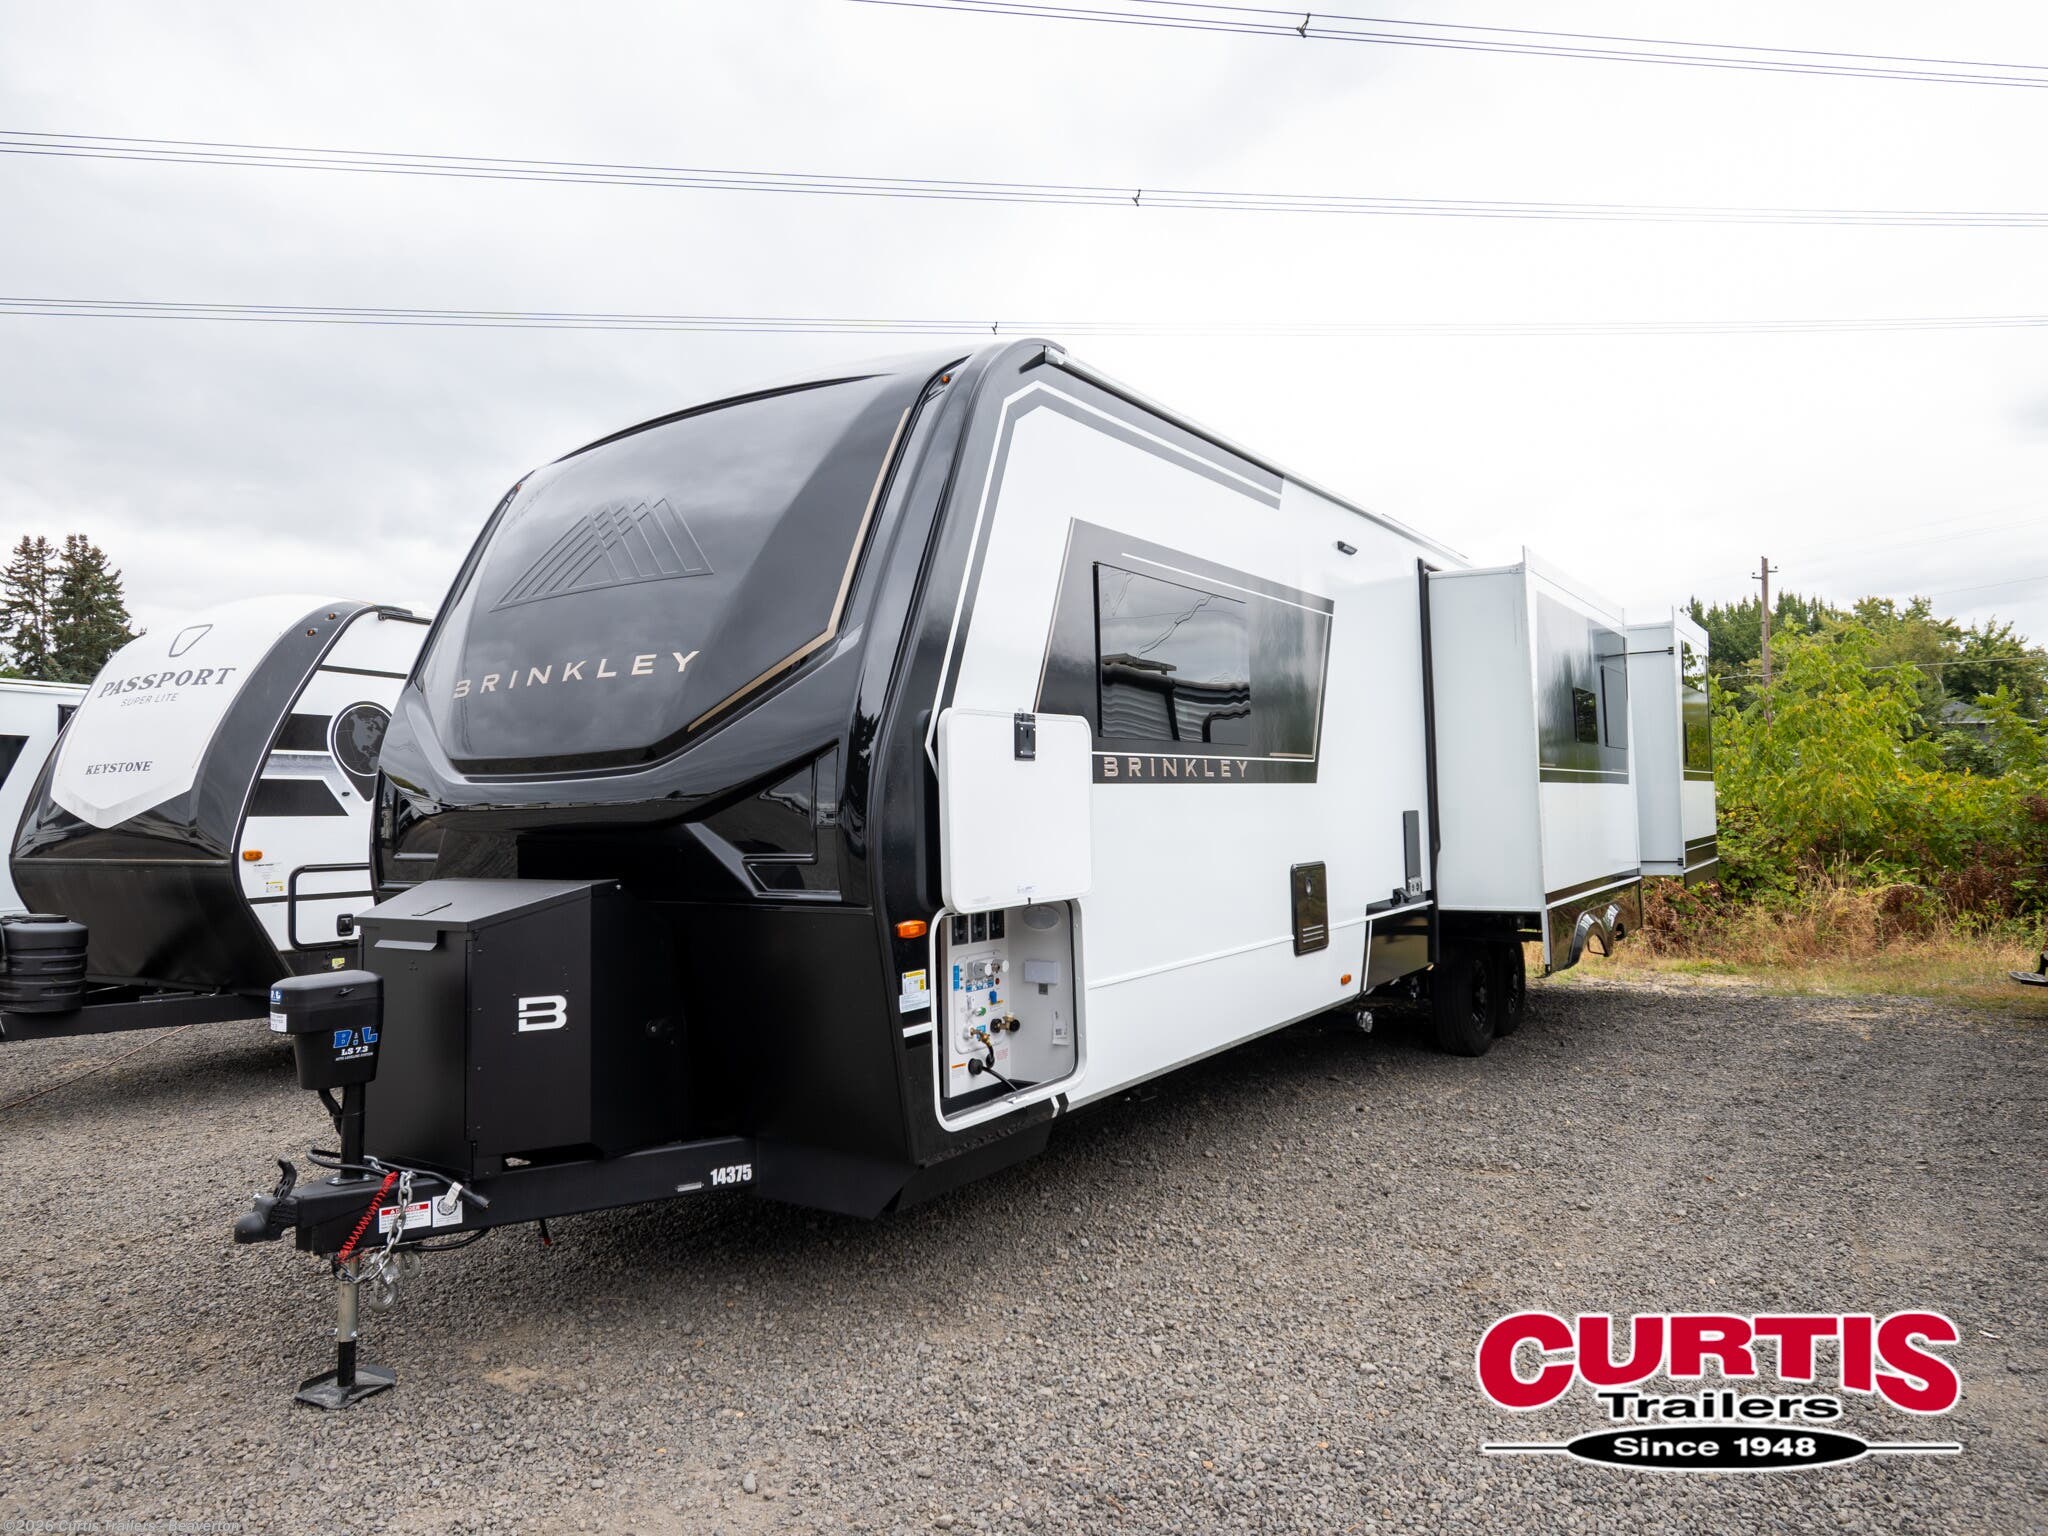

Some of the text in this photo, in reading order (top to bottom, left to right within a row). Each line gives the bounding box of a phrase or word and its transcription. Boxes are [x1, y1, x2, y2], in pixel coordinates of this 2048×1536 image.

[97, 667, 237, 698] PASSPORT
[452, 650, 700, 699] BRINKLEY
[120, 693, 179, 707] SUPER LITE
[85, 761, 153, 775] KEYSTONE
[1103, 757, 1248, 778] BRINKLEY
[710, 1164, 752, 1186] 14375
